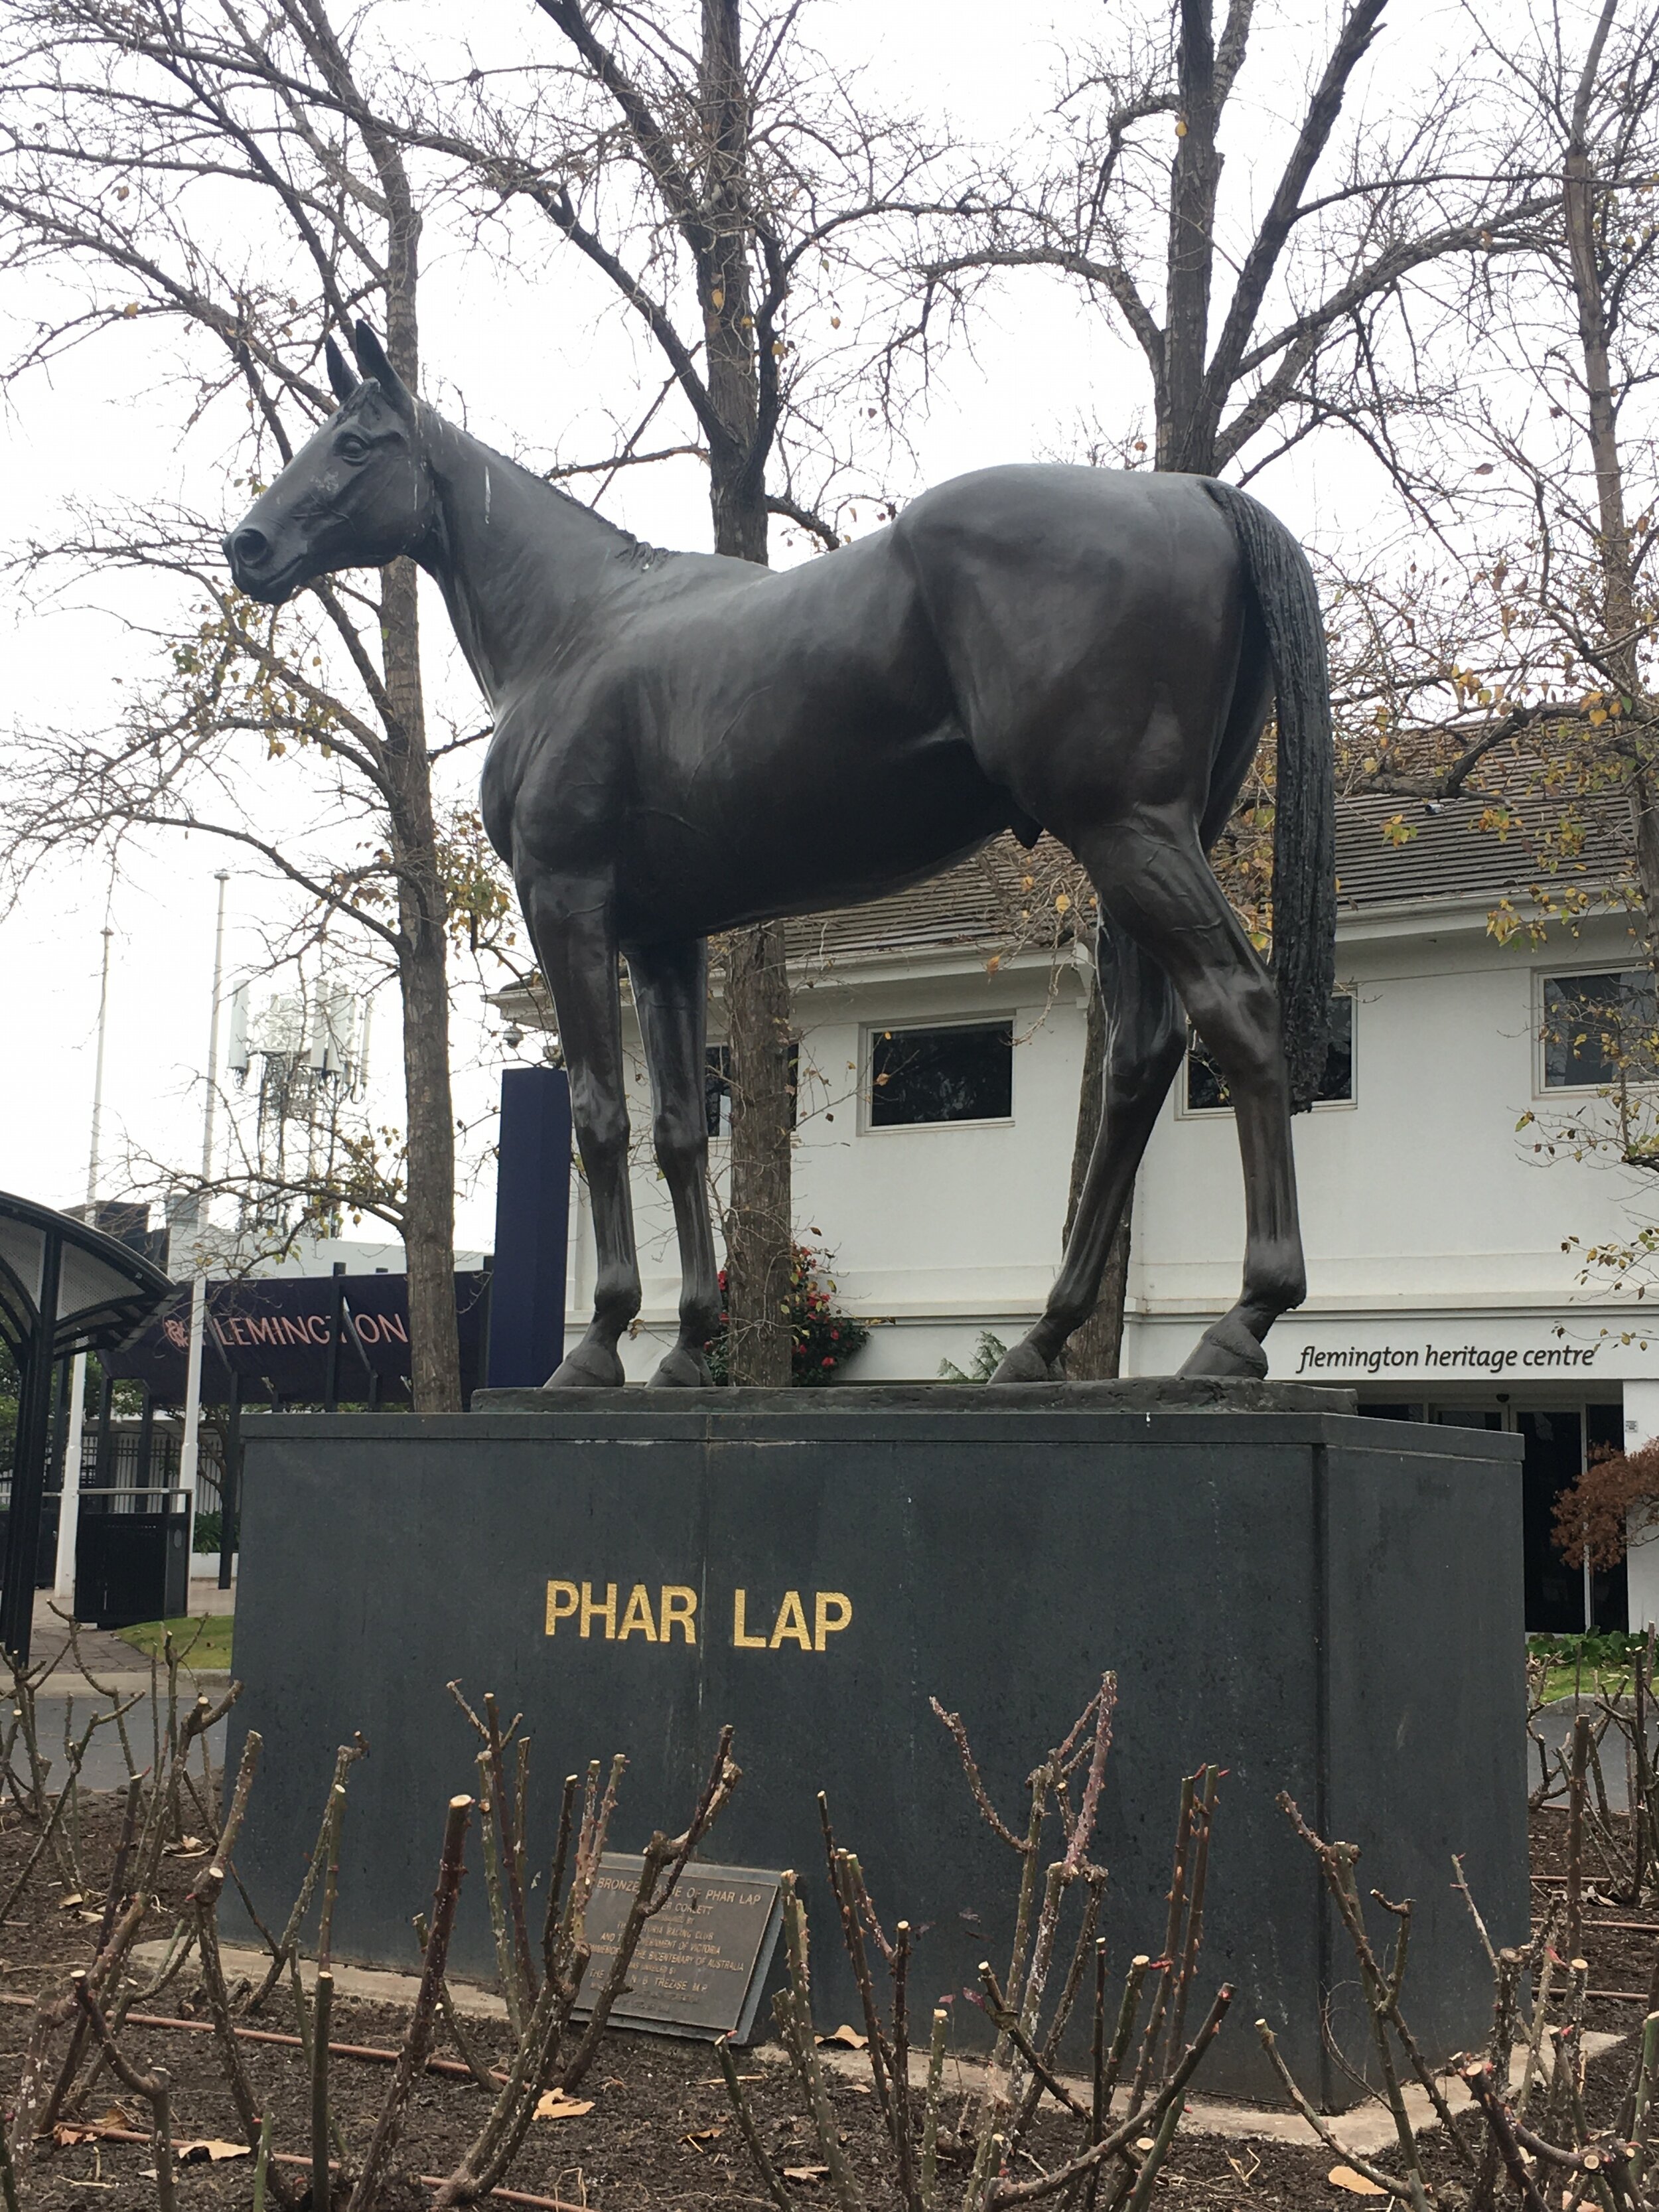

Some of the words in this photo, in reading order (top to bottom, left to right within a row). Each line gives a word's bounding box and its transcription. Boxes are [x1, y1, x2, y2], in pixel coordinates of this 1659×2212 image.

[1296, 1346, 1418, 1373] flemington
[1425, 1345, 1517, 1372] heritage
[1523, 1346, 1594, 1366] centre
[545, 1580, 697, 1644] PHAR
[734, 1589, 852, 1651] LAP
[597, 1878, 641, 1893] BRONZE
[705, 1889, 735, 1903] PHAR
[739, 1893, 761, 1905] LAP
[600, 1933, 616, 1942] AND
[589, 1968, 605, 1978] THE
[707, 1959, 744, 1971] AUSTRALIA
